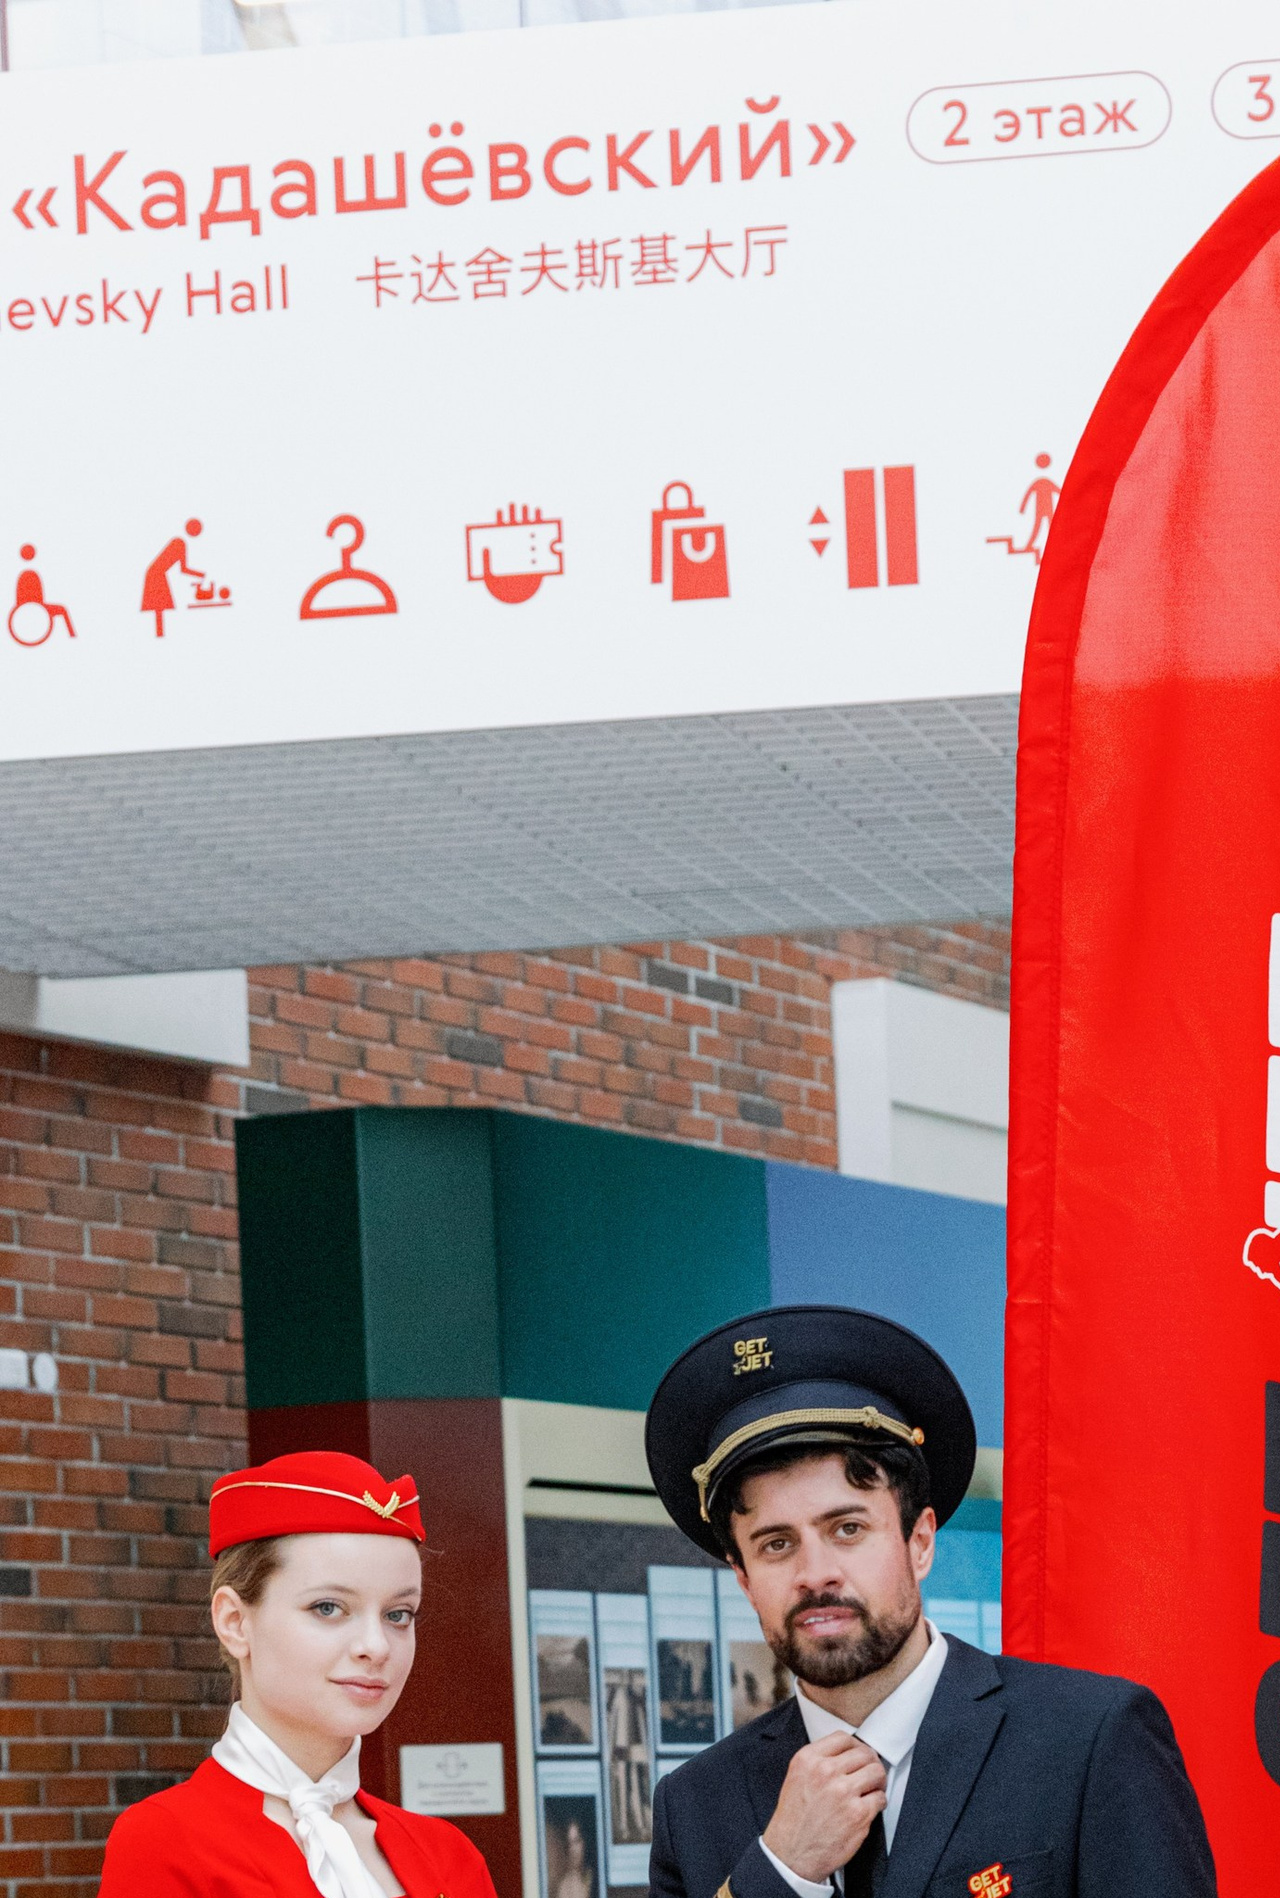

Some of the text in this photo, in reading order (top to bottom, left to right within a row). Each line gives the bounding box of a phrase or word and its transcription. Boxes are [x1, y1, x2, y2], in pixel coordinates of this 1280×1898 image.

[942, 99, 1138, 146] 2 этаж
[1247, 74, 1275, 123] 3
[12, 95, 857, 241] «Кадашёвский»
[186, 264, 289, 318] Hall
[355, 226, 788, 309] 卡达舍夫斯基大厅
[733, 1337, 768, 1357] GET
[741, 1350, 774, 1372] JET
[969, 1864, 1001, 1893] GET
